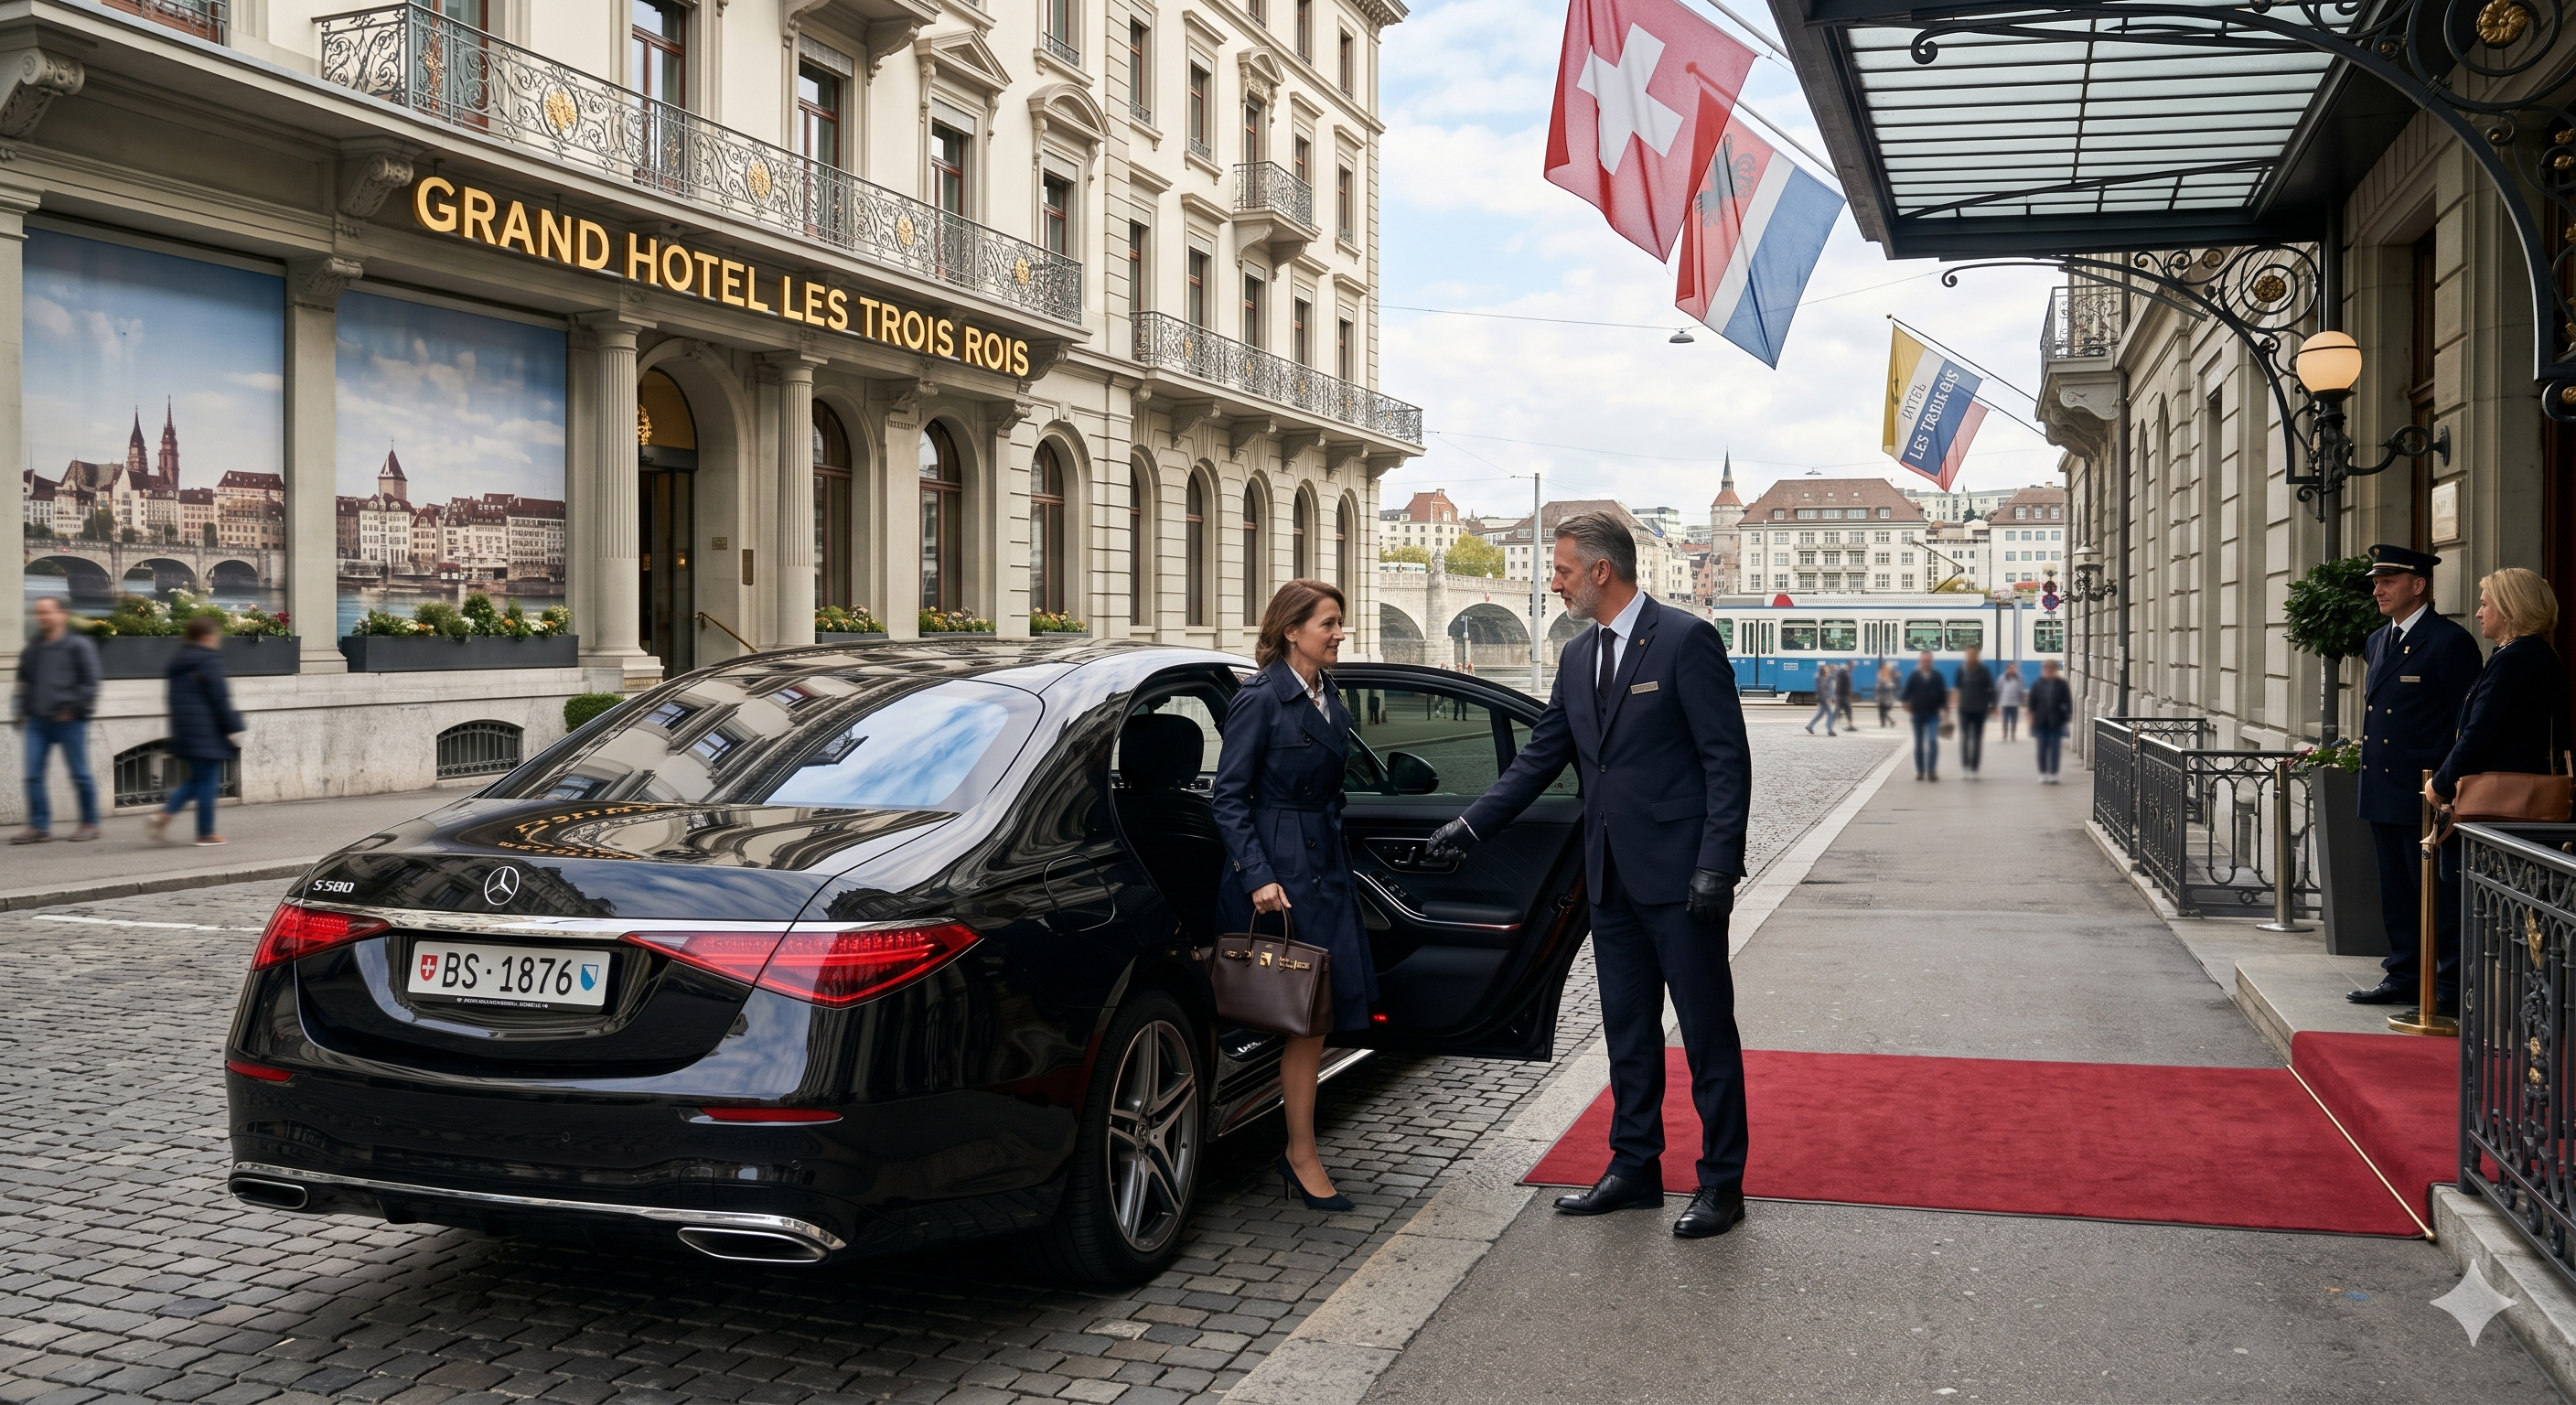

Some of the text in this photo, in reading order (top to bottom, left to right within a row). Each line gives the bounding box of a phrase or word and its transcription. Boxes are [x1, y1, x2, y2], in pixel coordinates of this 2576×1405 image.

[413, 177, 1029, 377] GRAND HOTEL LES TROIS ROIS
[1909, 434, 1929, 460] LES
